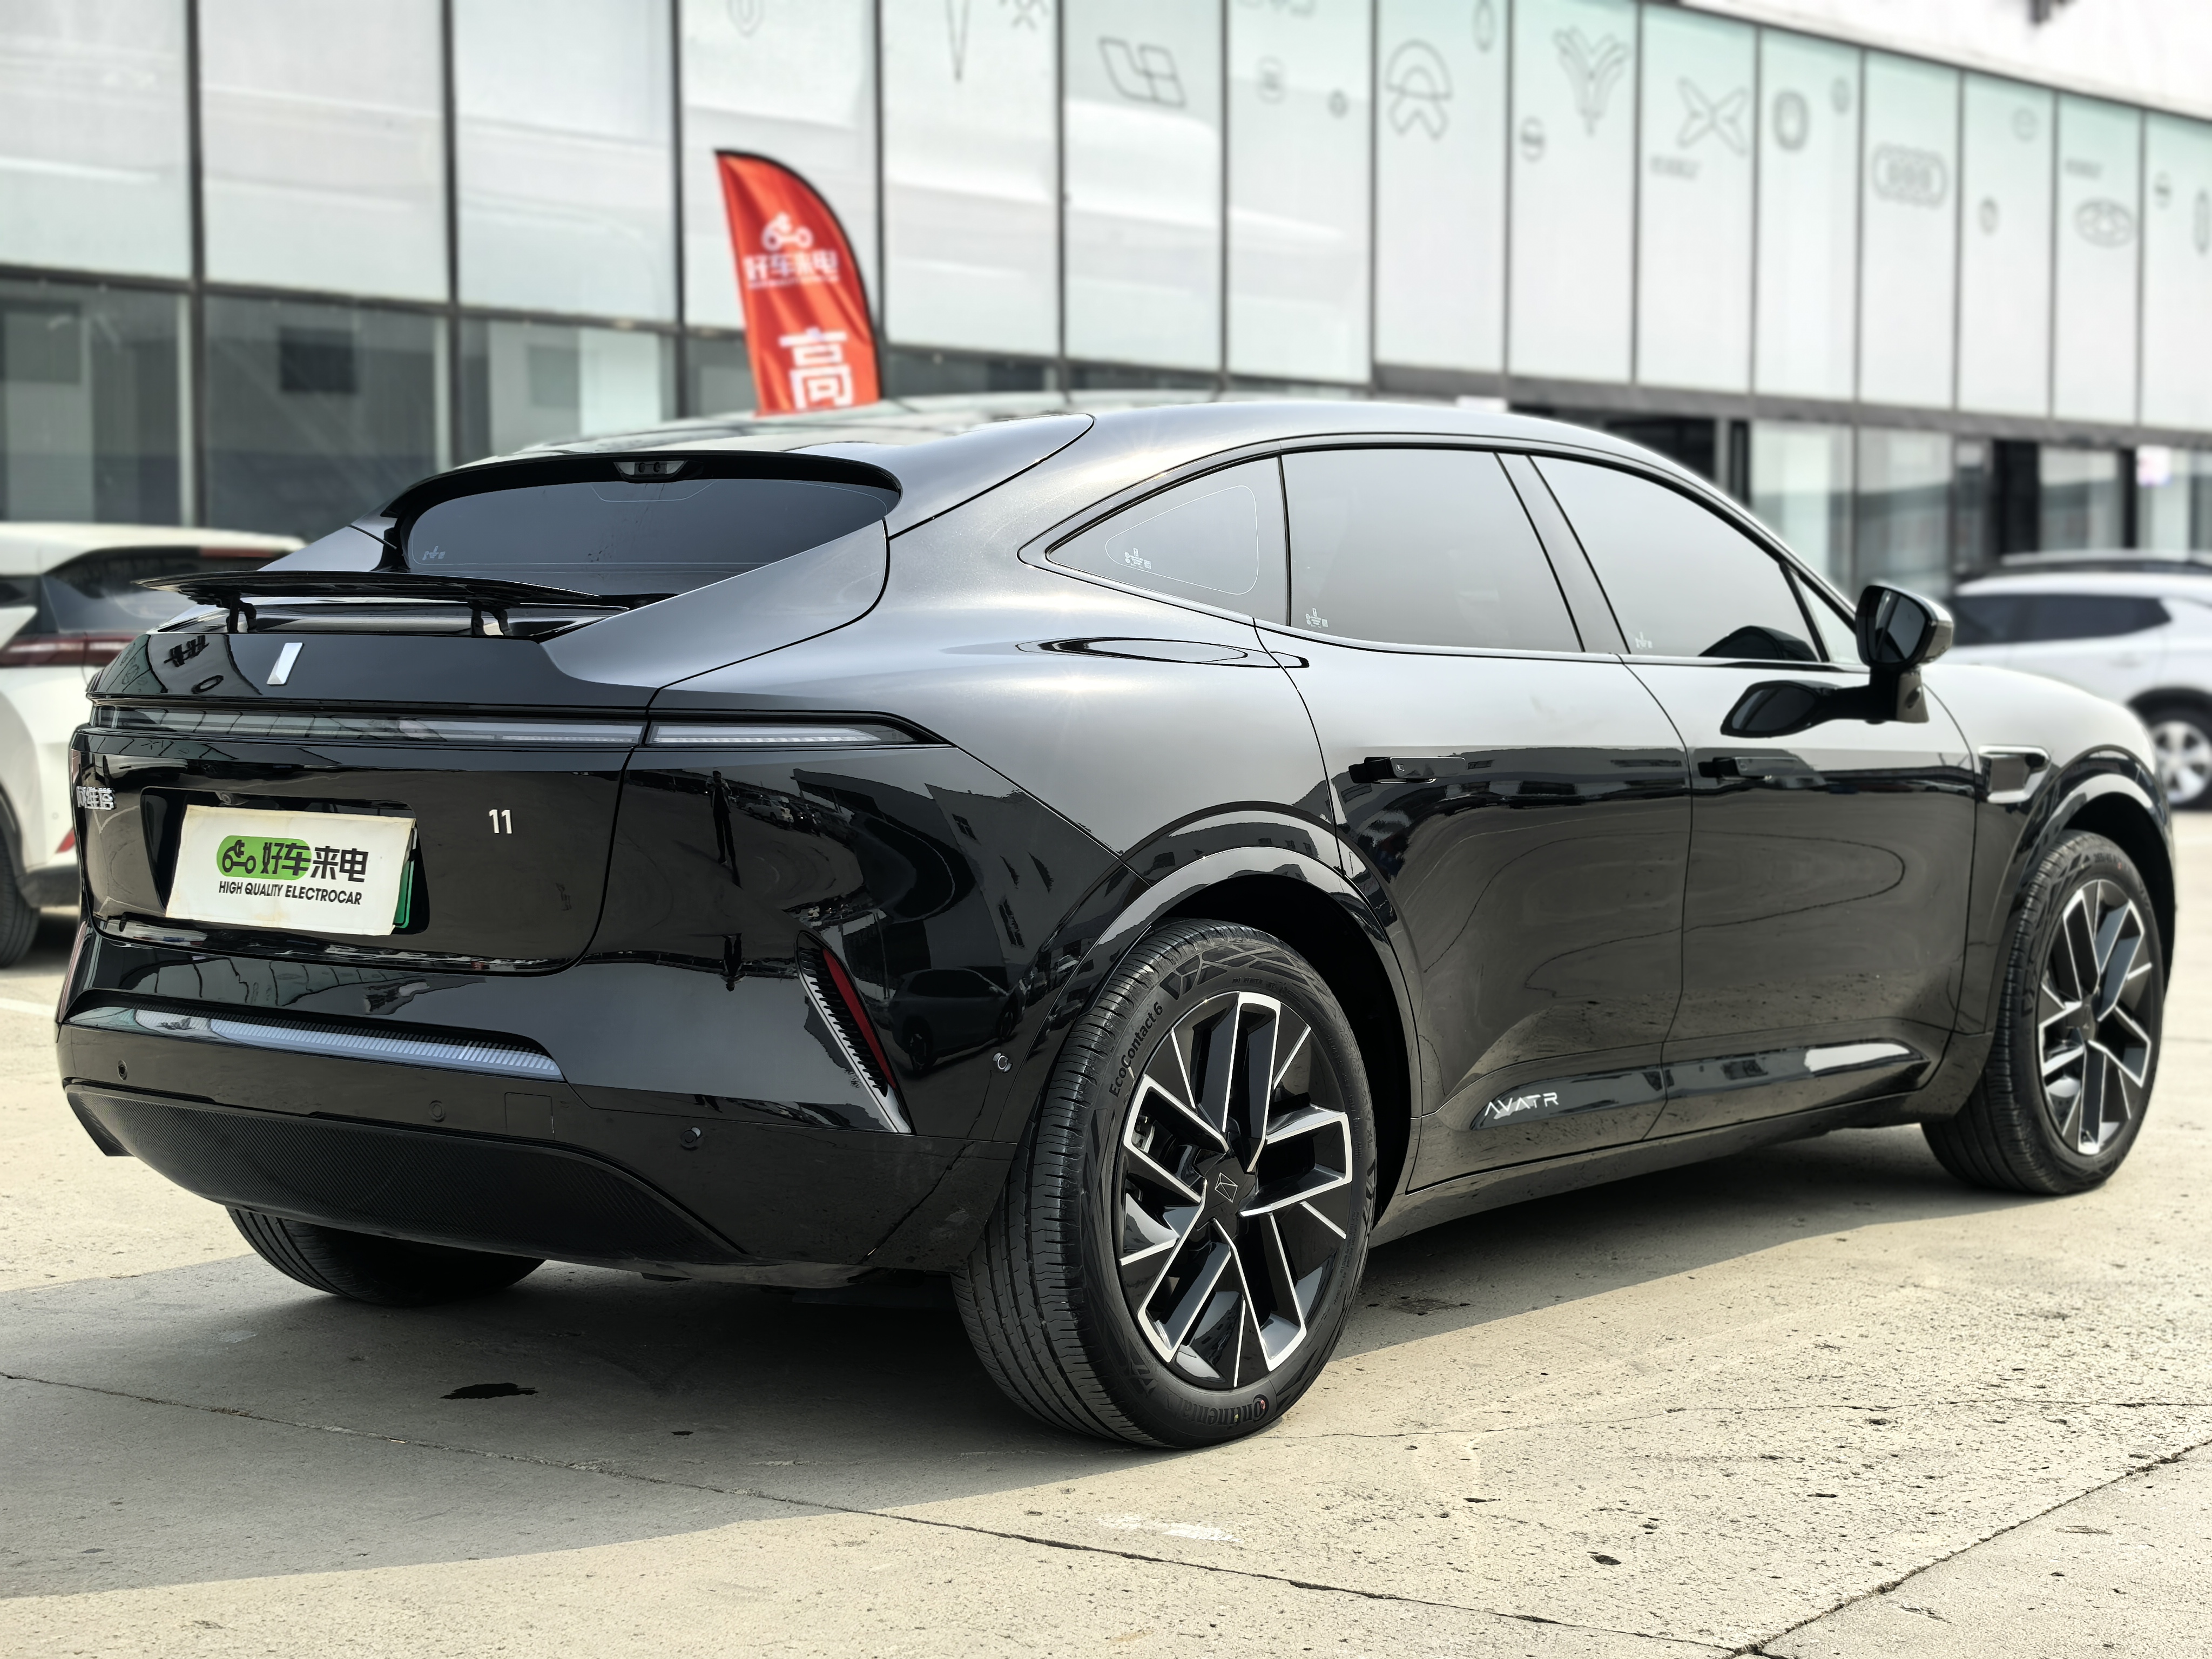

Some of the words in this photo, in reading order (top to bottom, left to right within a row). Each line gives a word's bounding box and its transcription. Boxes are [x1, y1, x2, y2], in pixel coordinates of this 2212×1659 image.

[778, 326, 853, 411] 高
[489, 809, 512, 834] 11
[260, 842, 369, 883] 好车来电
[219, 881, 243, 894] HIGH
[245, 882, 284, 896] QUALITY
[285, 885, 362, 905] ELECTROCAR
[1109, 1011, 1156, 1098] EcoContact
[1153, 1001, 1163, 1016] 6
